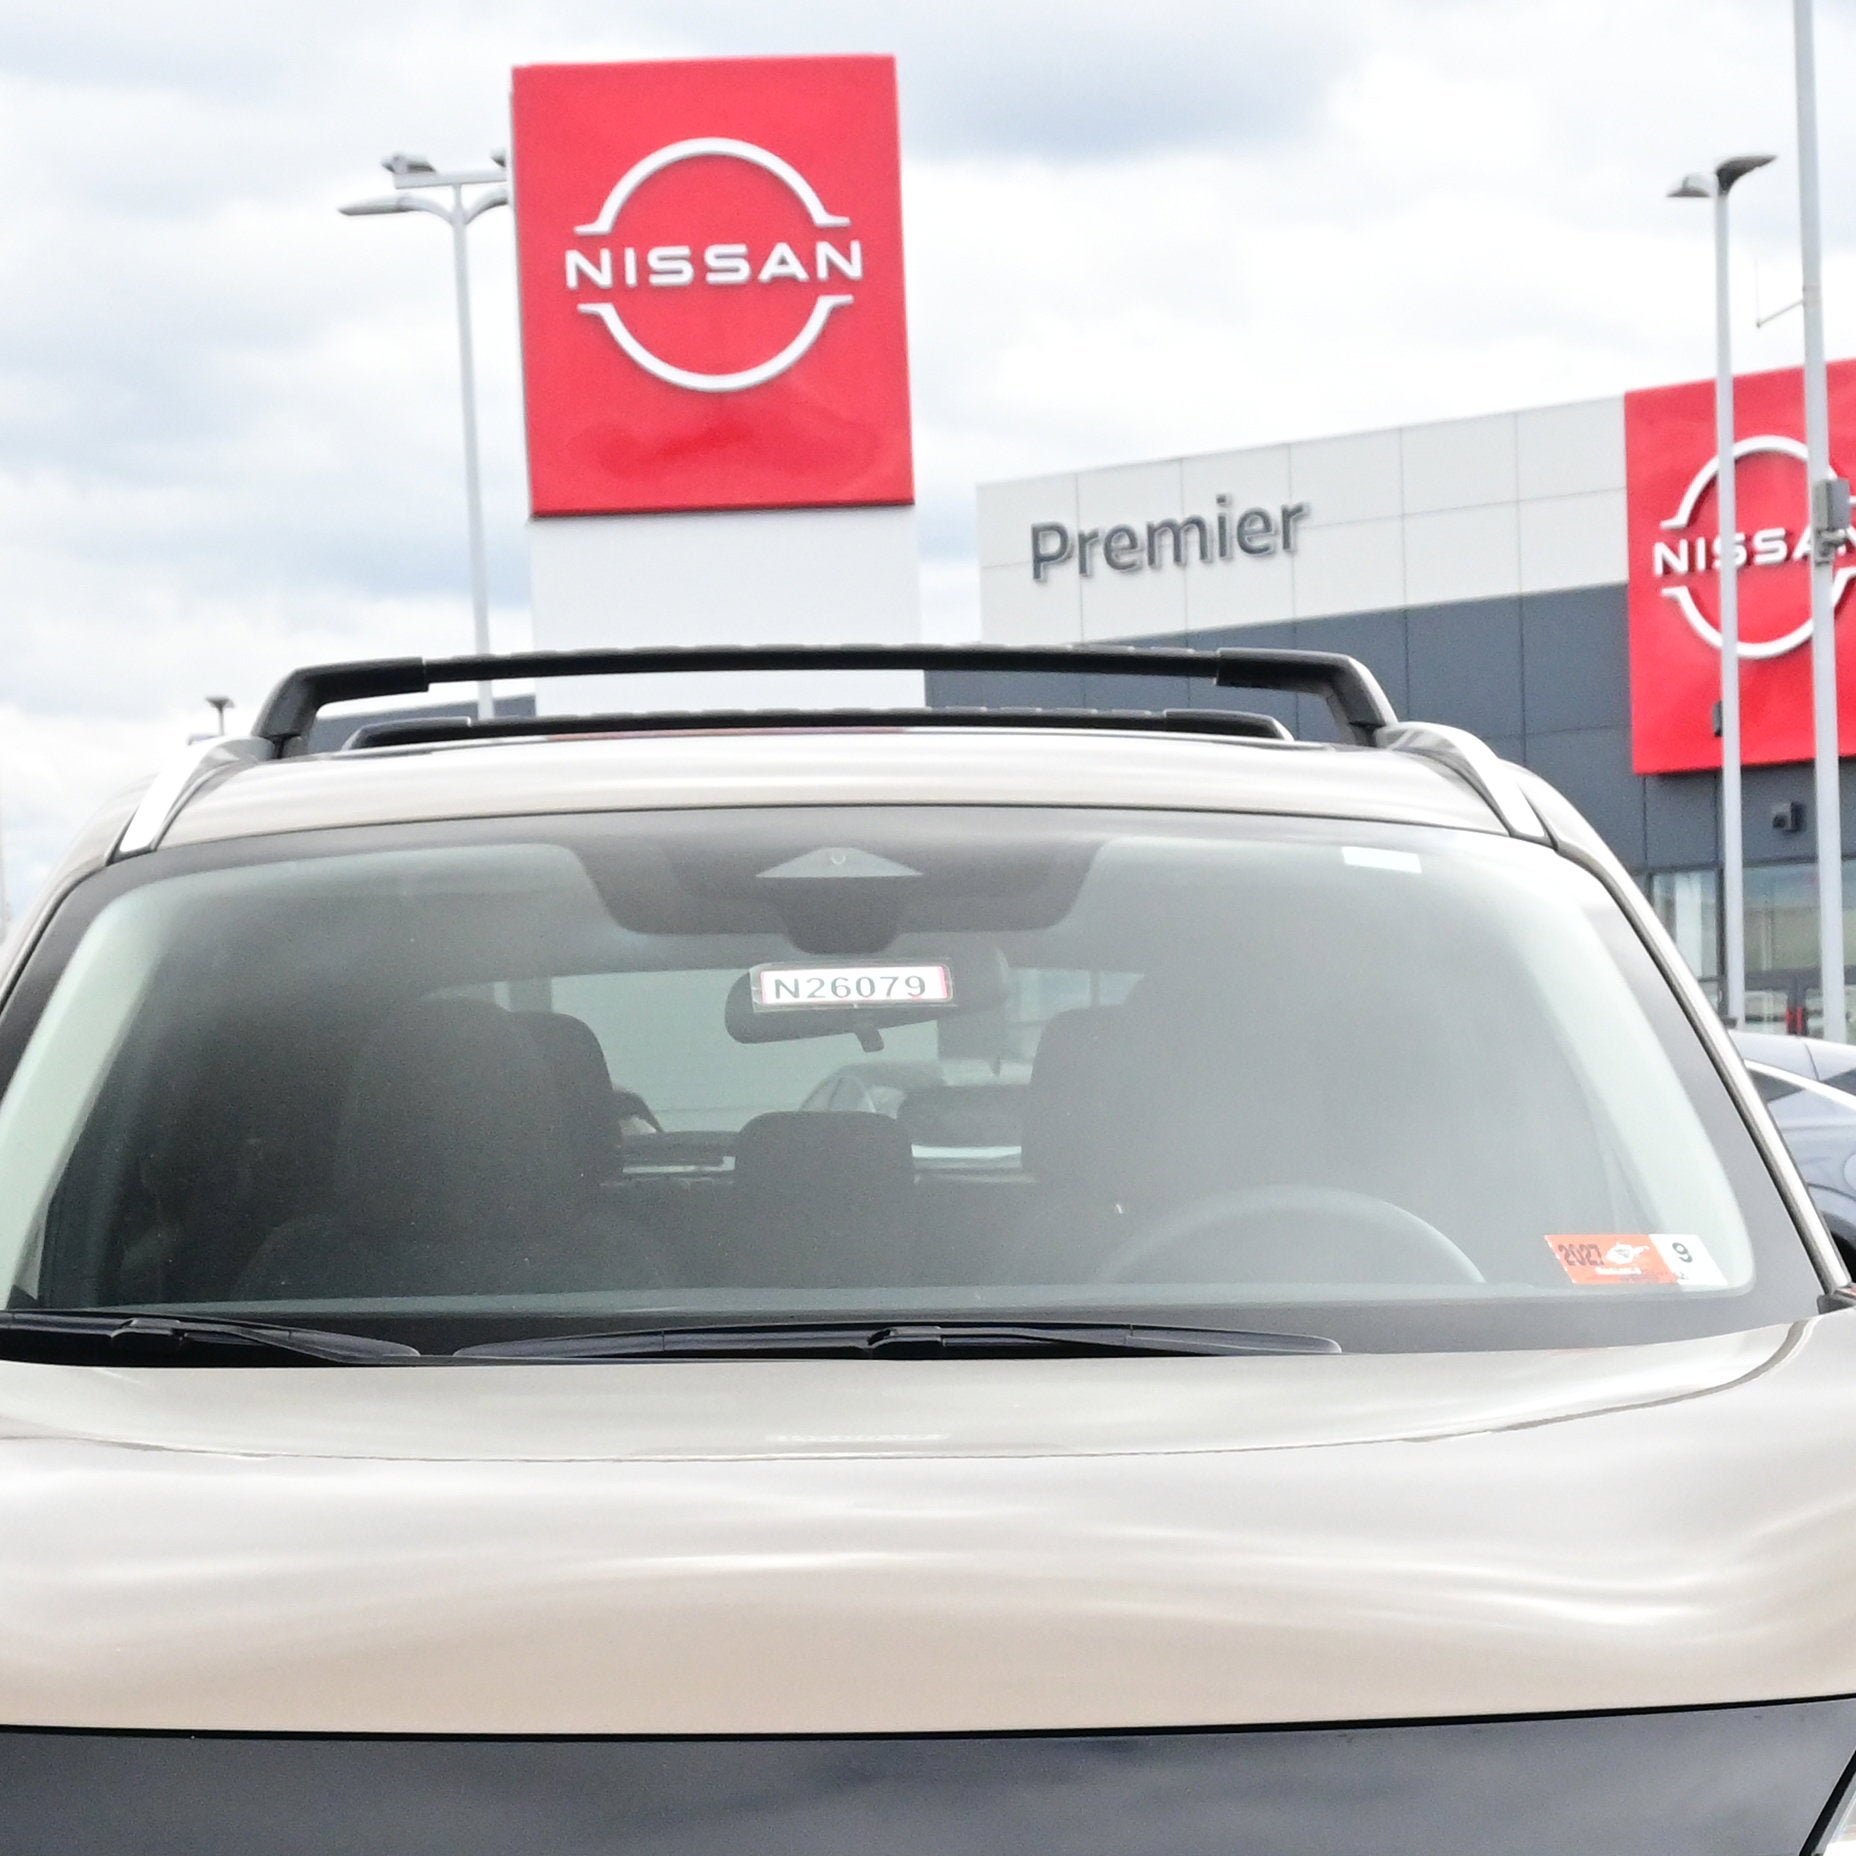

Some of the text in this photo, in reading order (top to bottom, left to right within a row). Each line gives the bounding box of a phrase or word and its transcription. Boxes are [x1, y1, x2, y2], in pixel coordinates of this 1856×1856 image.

[565, 239, 863, 289] NISSAN
[1031, 493, 1309, 582] Premier
[774, 975, 926, 999] N26079
[1558, 1243, 1605, 1267] 2027
[1671, 1242, 1693, 1264] 9
